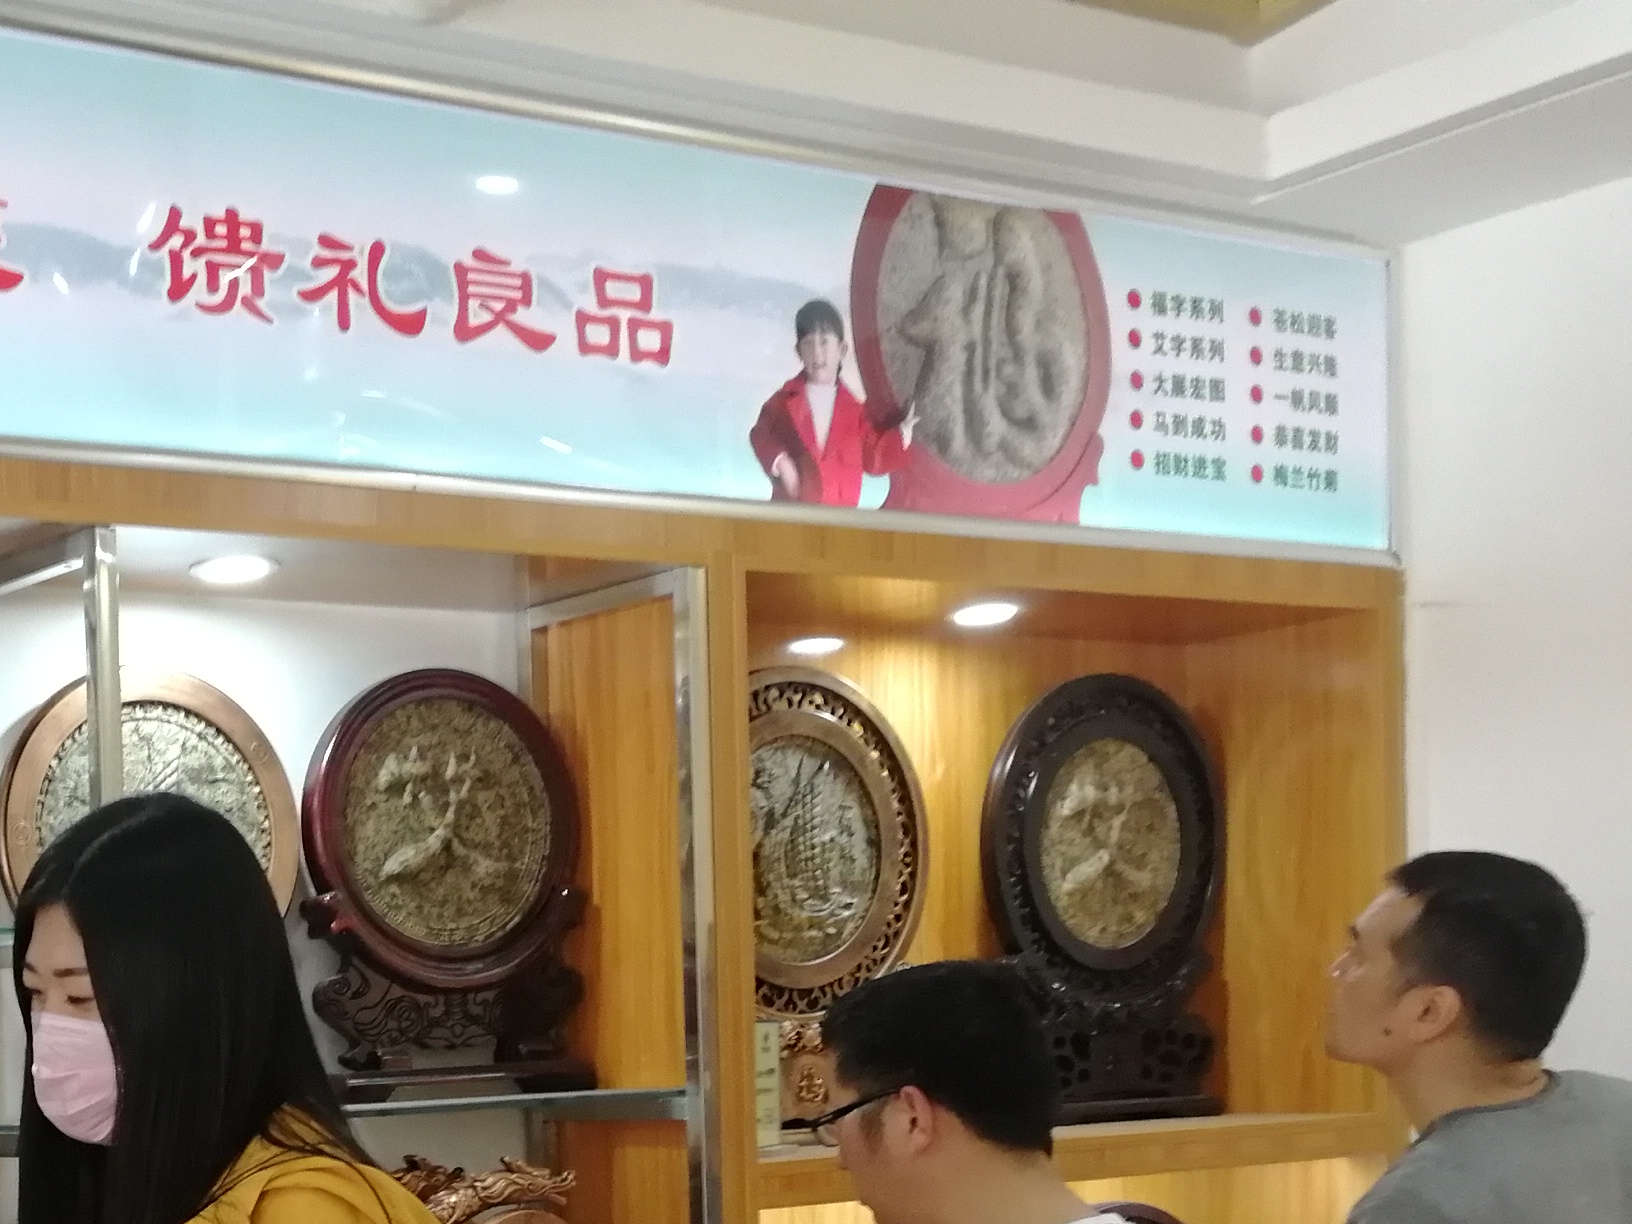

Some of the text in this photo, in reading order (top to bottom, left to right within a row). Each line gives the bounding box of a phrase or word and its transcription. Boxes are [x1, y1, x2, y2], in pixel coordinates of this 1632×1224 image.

[148, 206, 672, 363] 馈礼良品
[1151, 290, 1225, 324] 福字系列
[1152, 331, 1225, 364] 艾字系列
[1273, 348, 1338, 379] 生意兴隆
[1153, 370, 1226, 403] 大展宏图
[1273, 388, 1339, 417] 一帆风顺
[1153, 411, 1226, 442] 马到成功
[1273, 425, 1339, 455] 恭喜发财
[1154, 451, 1227, 482] 招财进宝
[1272, 463, 1338, 493] 梅兰竹菊
